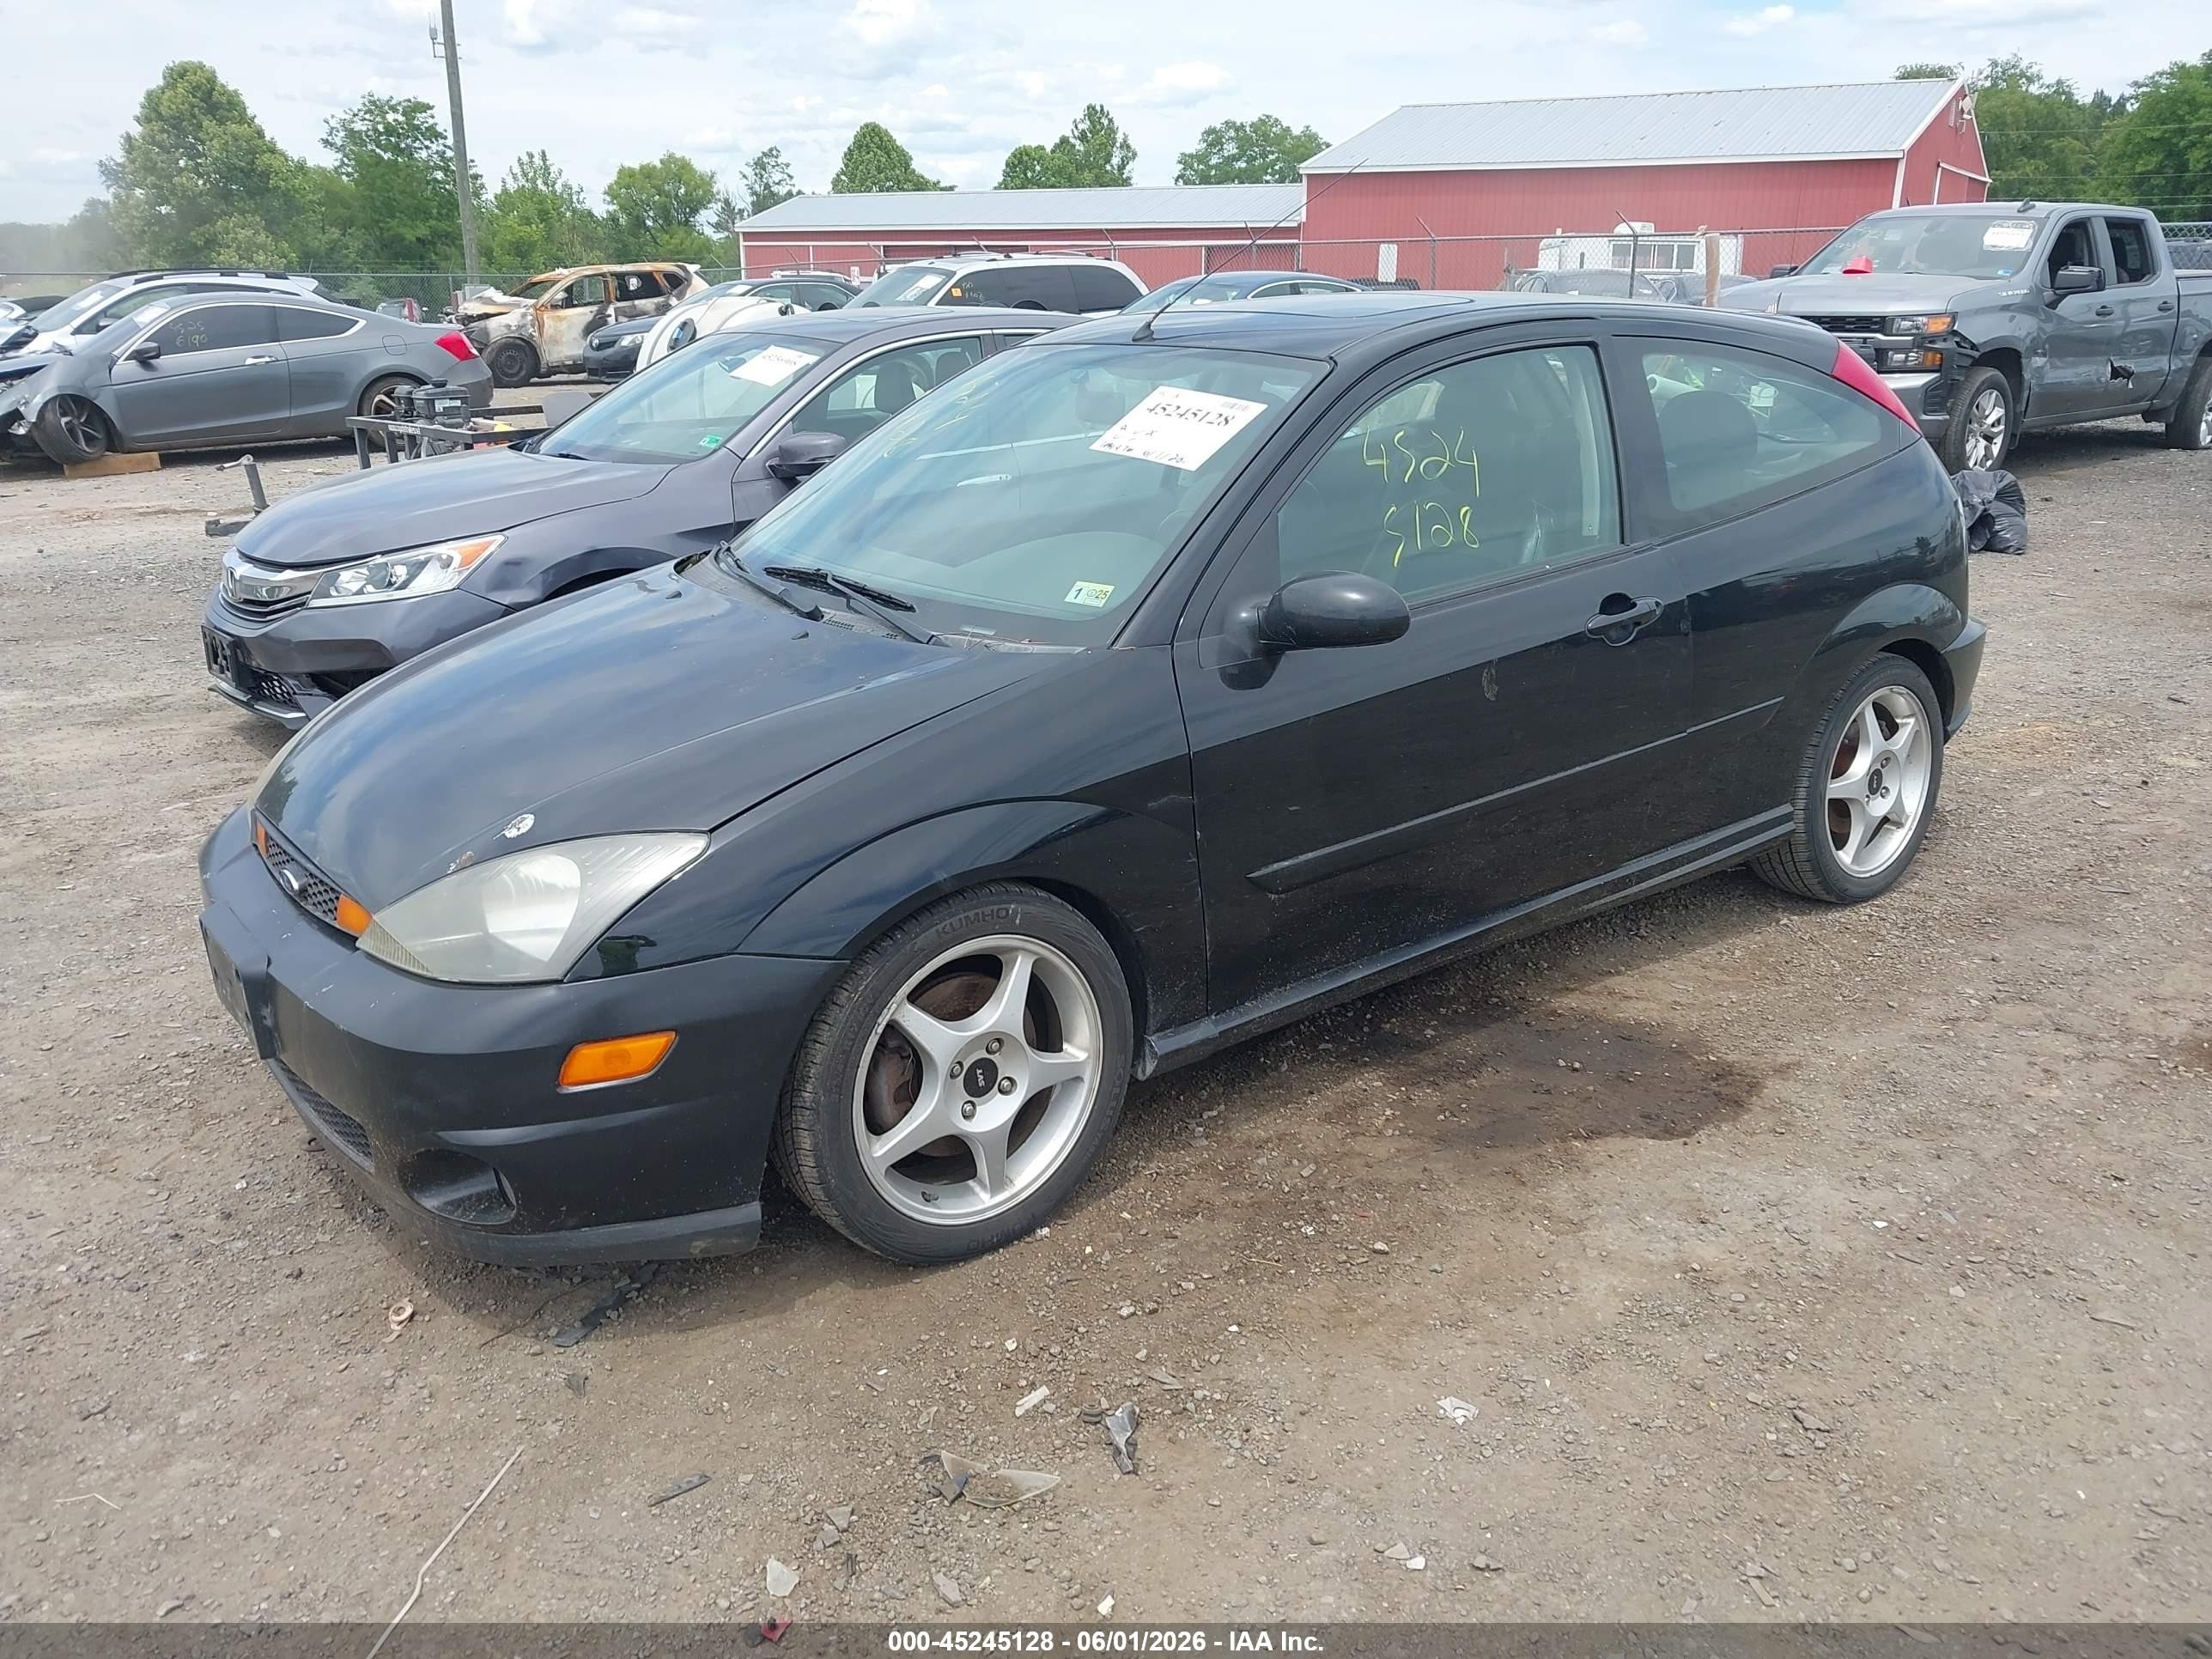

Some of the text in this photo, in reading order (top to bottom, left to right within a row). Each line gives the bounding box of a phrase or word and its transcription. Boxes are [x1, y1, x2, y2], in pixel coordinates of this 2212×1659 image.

[176, 334, 208, 348] 6190
[1146, 402, 1236, 428] 45245128
[1362, 425, 1480, 498] 4524
[1382, 500, 1480, 568] 5128
[1073, 587, 1109, 600] 1 25
[935, 906, 1009, 936] KUMHO
[975, 1067, 986, 1088] SVT
